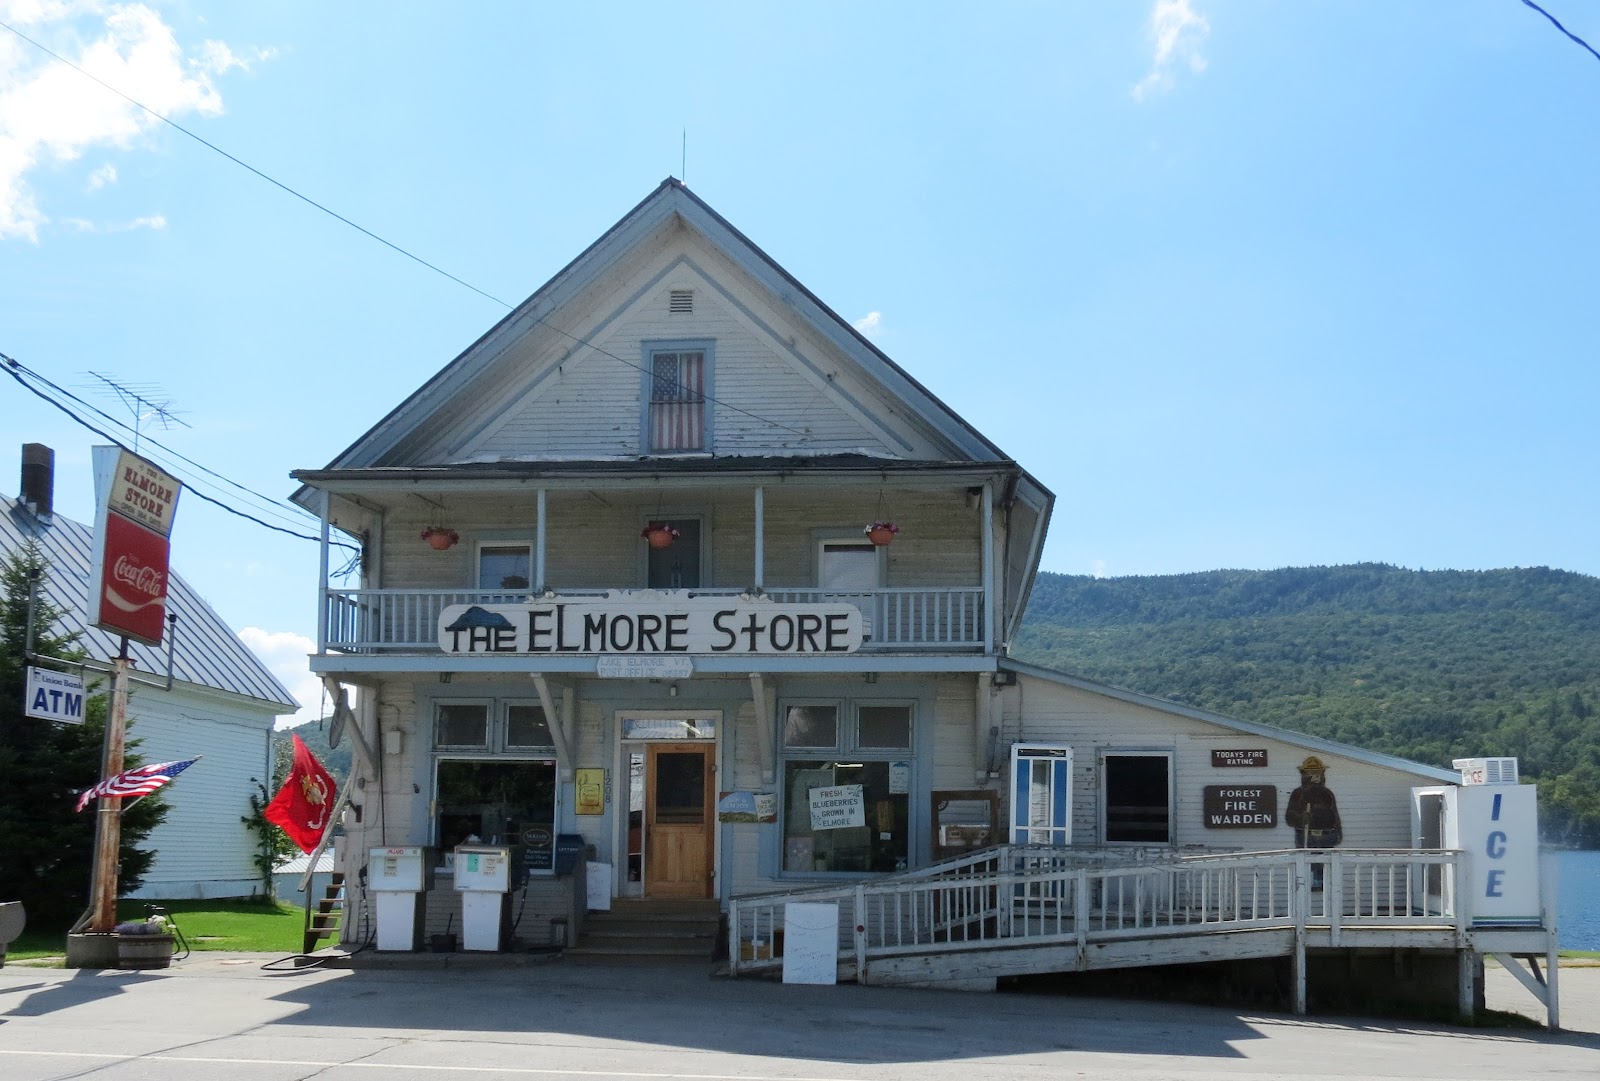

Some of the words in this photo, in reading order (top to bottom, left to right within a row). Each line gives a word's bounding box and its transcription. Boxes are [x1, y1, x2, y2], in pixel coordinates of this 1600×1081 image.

[124, 467, 173, 504] ELMORE
[125, 487, 164, 519] STORE
[445, 626, 517, 652] THE
[528, 604, 690, 652] ELMORE
[32, 687, 82, 718] ATM
[1216, 751, 1244, 759] TODAYS
[820, 790, 843, 799] FRESH
[1220, 789, 1262, 798] FOREST
[812, 799, 859, 809] BLUEBERRIES
[1224, 801, 1257, 811] FIRE
[821, 808, 845, 818] GROWN
[848, 807, 856, 815] IN
[822, 818, 851, 827] ELMORE
[1211, 813, 1272, 825] WARDEN
[1485, 793, 1507, 898] ICE
